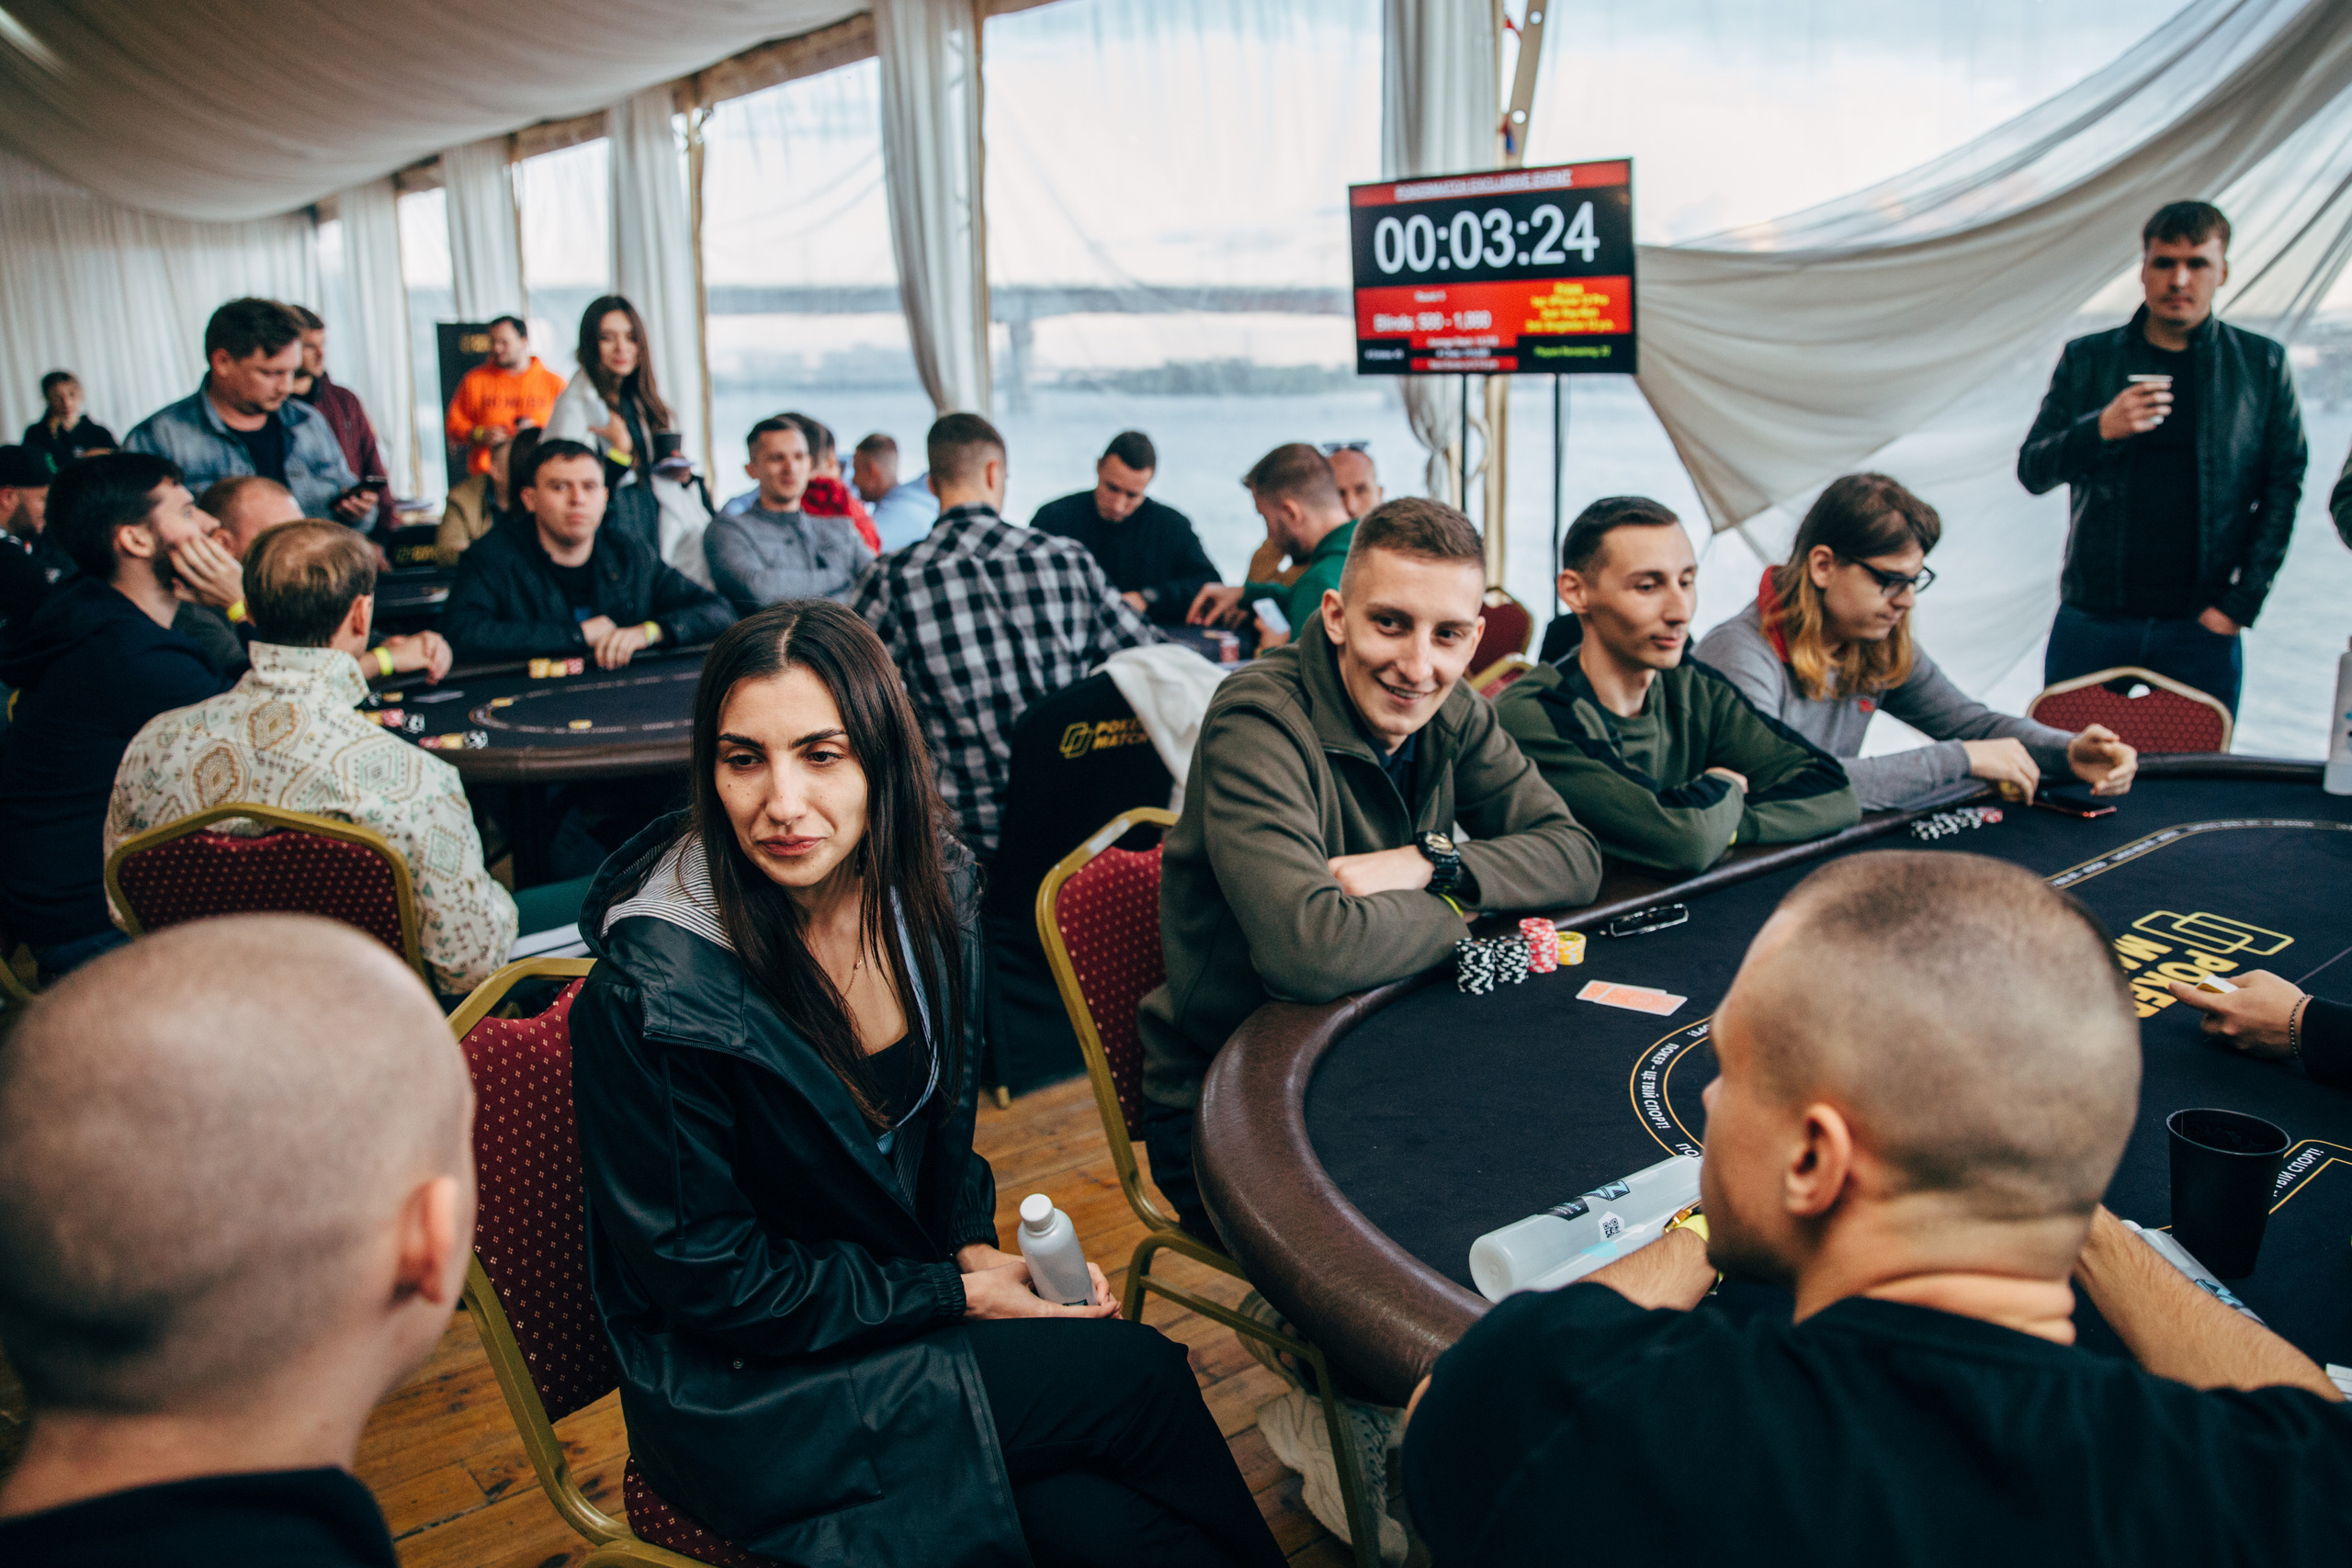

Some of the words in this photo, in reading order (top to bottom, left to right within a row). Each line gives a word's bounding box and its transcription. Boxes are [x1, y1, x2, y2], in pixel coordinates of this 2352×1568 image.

[1374, 201, 1600, 274] 00:03:24
[1651, 1043, 1680, 1066] ПОКЕР
[1641, 1070, 1657, 1080] ЦЕ
[1644, 1100, 1671, 1129] СПОРТ!
[2287, 1147, 2325, 1173] СПОРТ!
